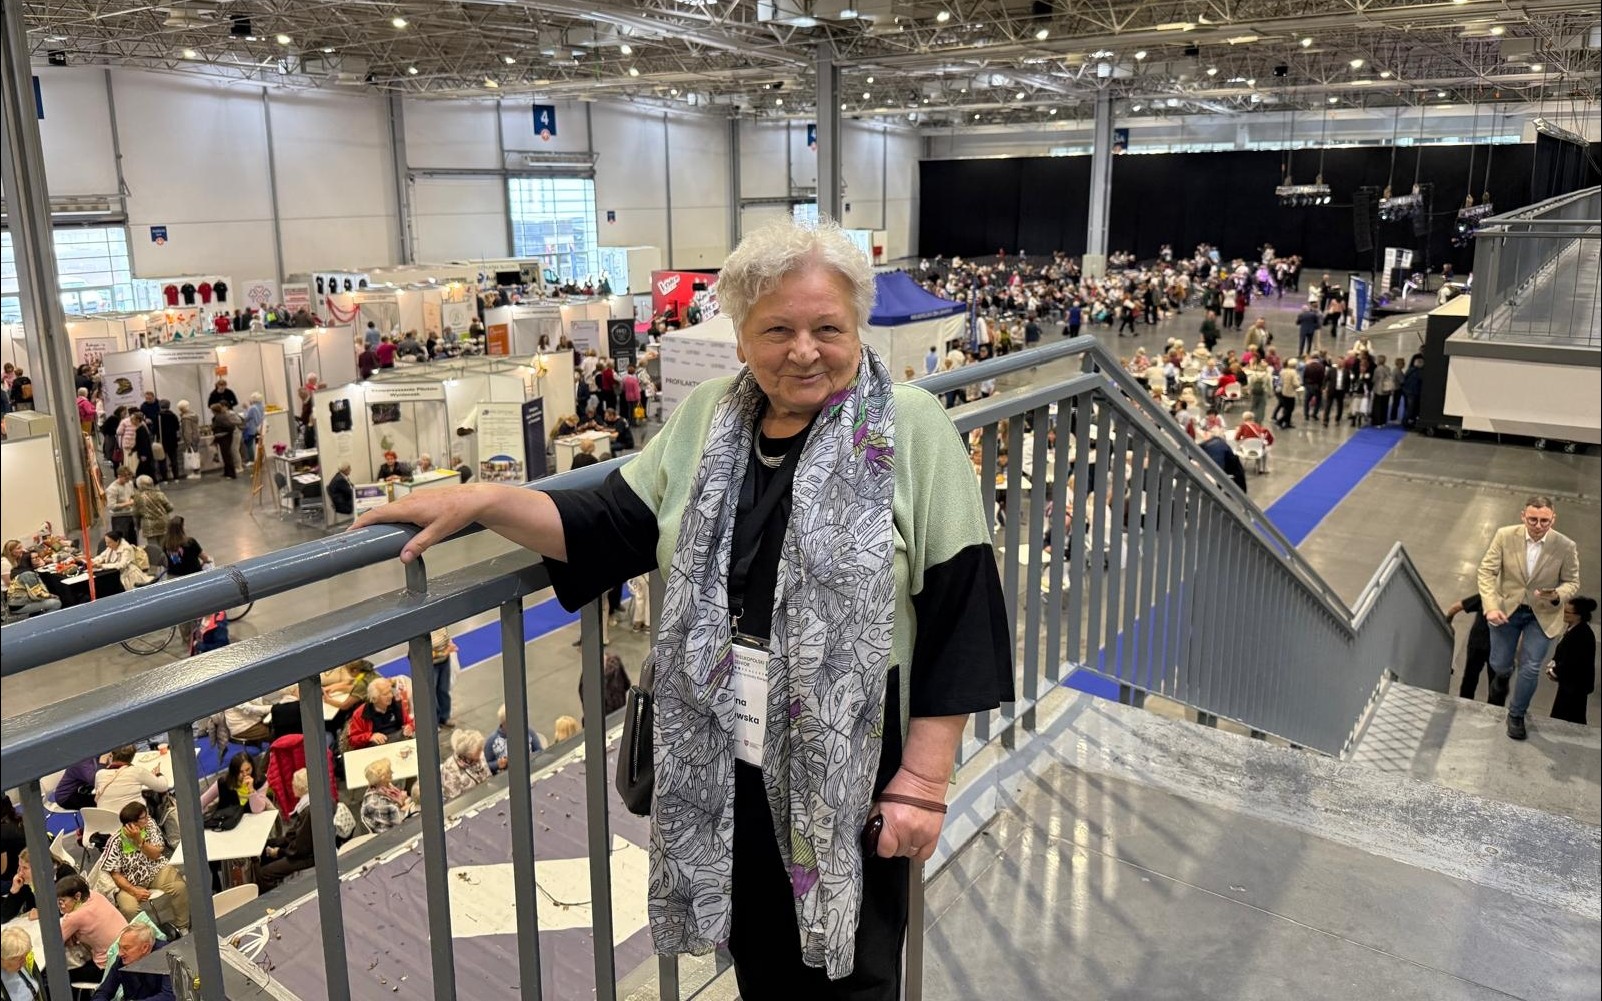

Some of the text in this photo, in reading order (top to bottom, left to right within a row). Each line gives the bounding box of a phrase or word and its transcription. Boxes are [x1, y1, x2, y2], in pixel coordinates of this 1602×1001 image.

[540, 110, 549, 126] 4
[735, 697, 747, 706] na
[735, 712, 760, 725] wska
